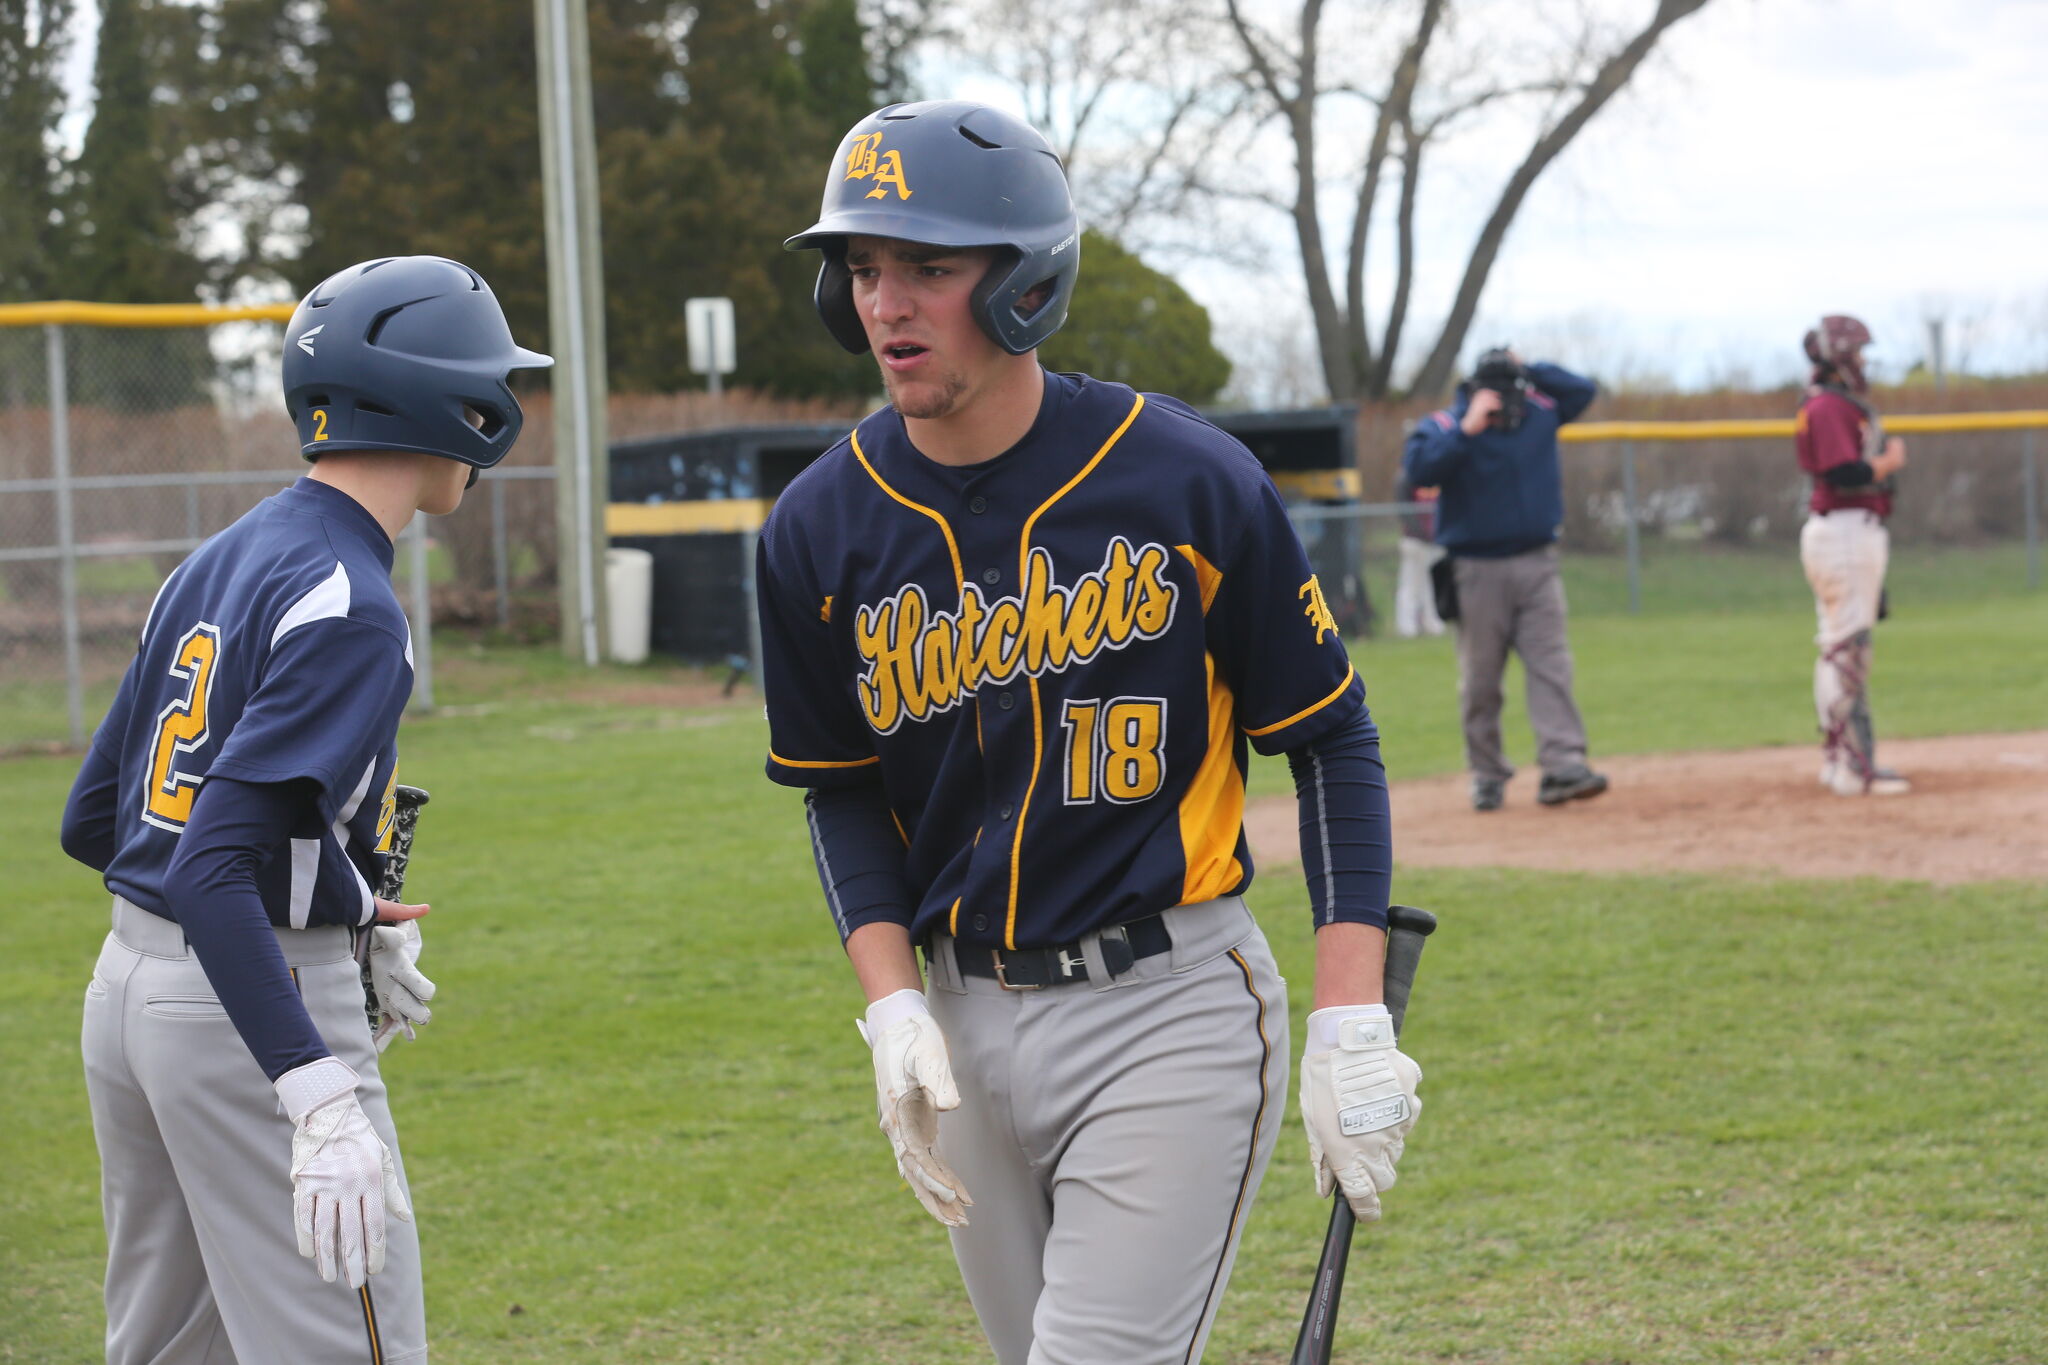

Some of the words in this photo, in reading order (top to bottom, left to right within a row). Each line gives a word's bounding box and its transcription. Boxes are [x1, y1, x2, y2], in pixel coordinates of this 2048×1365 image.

[843, 131, 914, 201] BA
[313, 409, 329, 442] 2
[855, 535, 1179, 736] Hatchets
[140, 620, 222, 834] 2
[1060, 695, 1168, 806] 18
